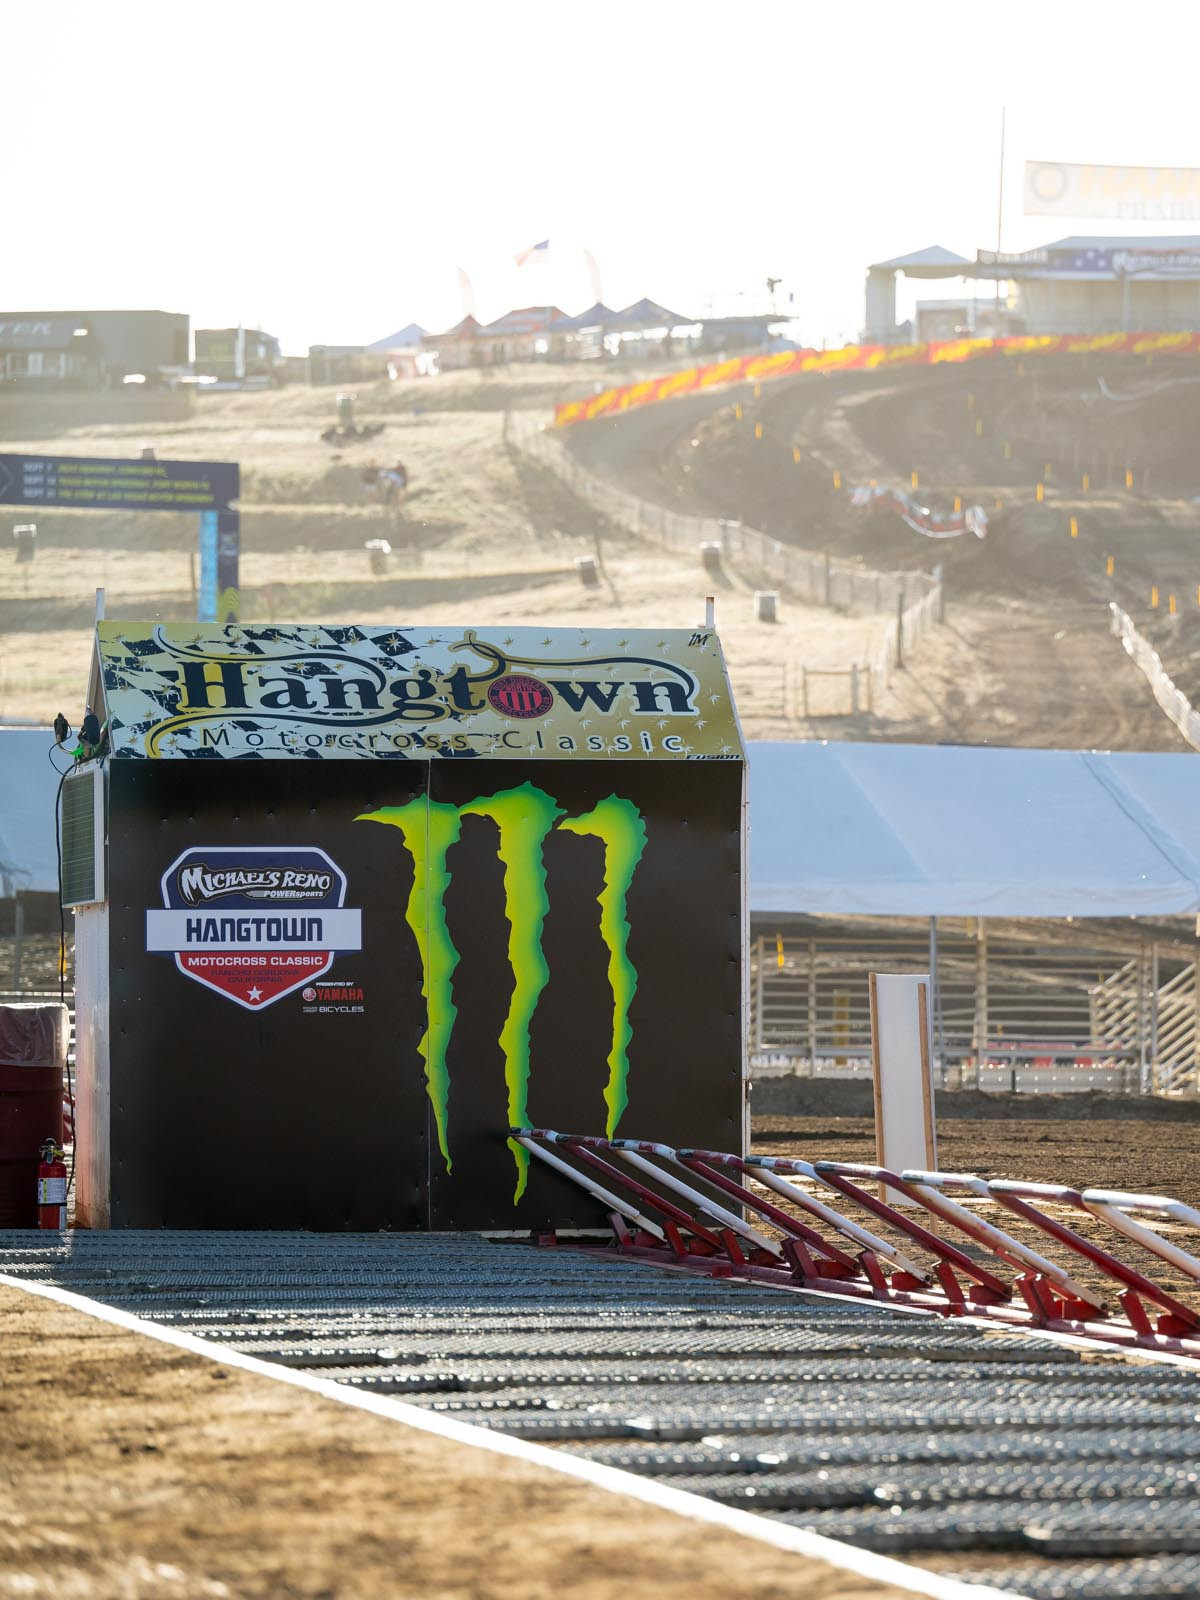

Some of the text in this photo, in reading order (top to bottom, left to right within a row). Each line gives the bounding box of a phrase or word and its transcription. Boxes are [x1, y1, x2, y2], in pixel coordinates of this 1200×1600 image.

[202, 728, 683, 751] Motocross Classic
[281, 870, 331, 889] RENO
[185, 917, 323, 943] HANGTOWN
[187, 956, 324, 967] MOTOCROSS CLASSIC
[316, 988, 365, 1001] YAMAHA
